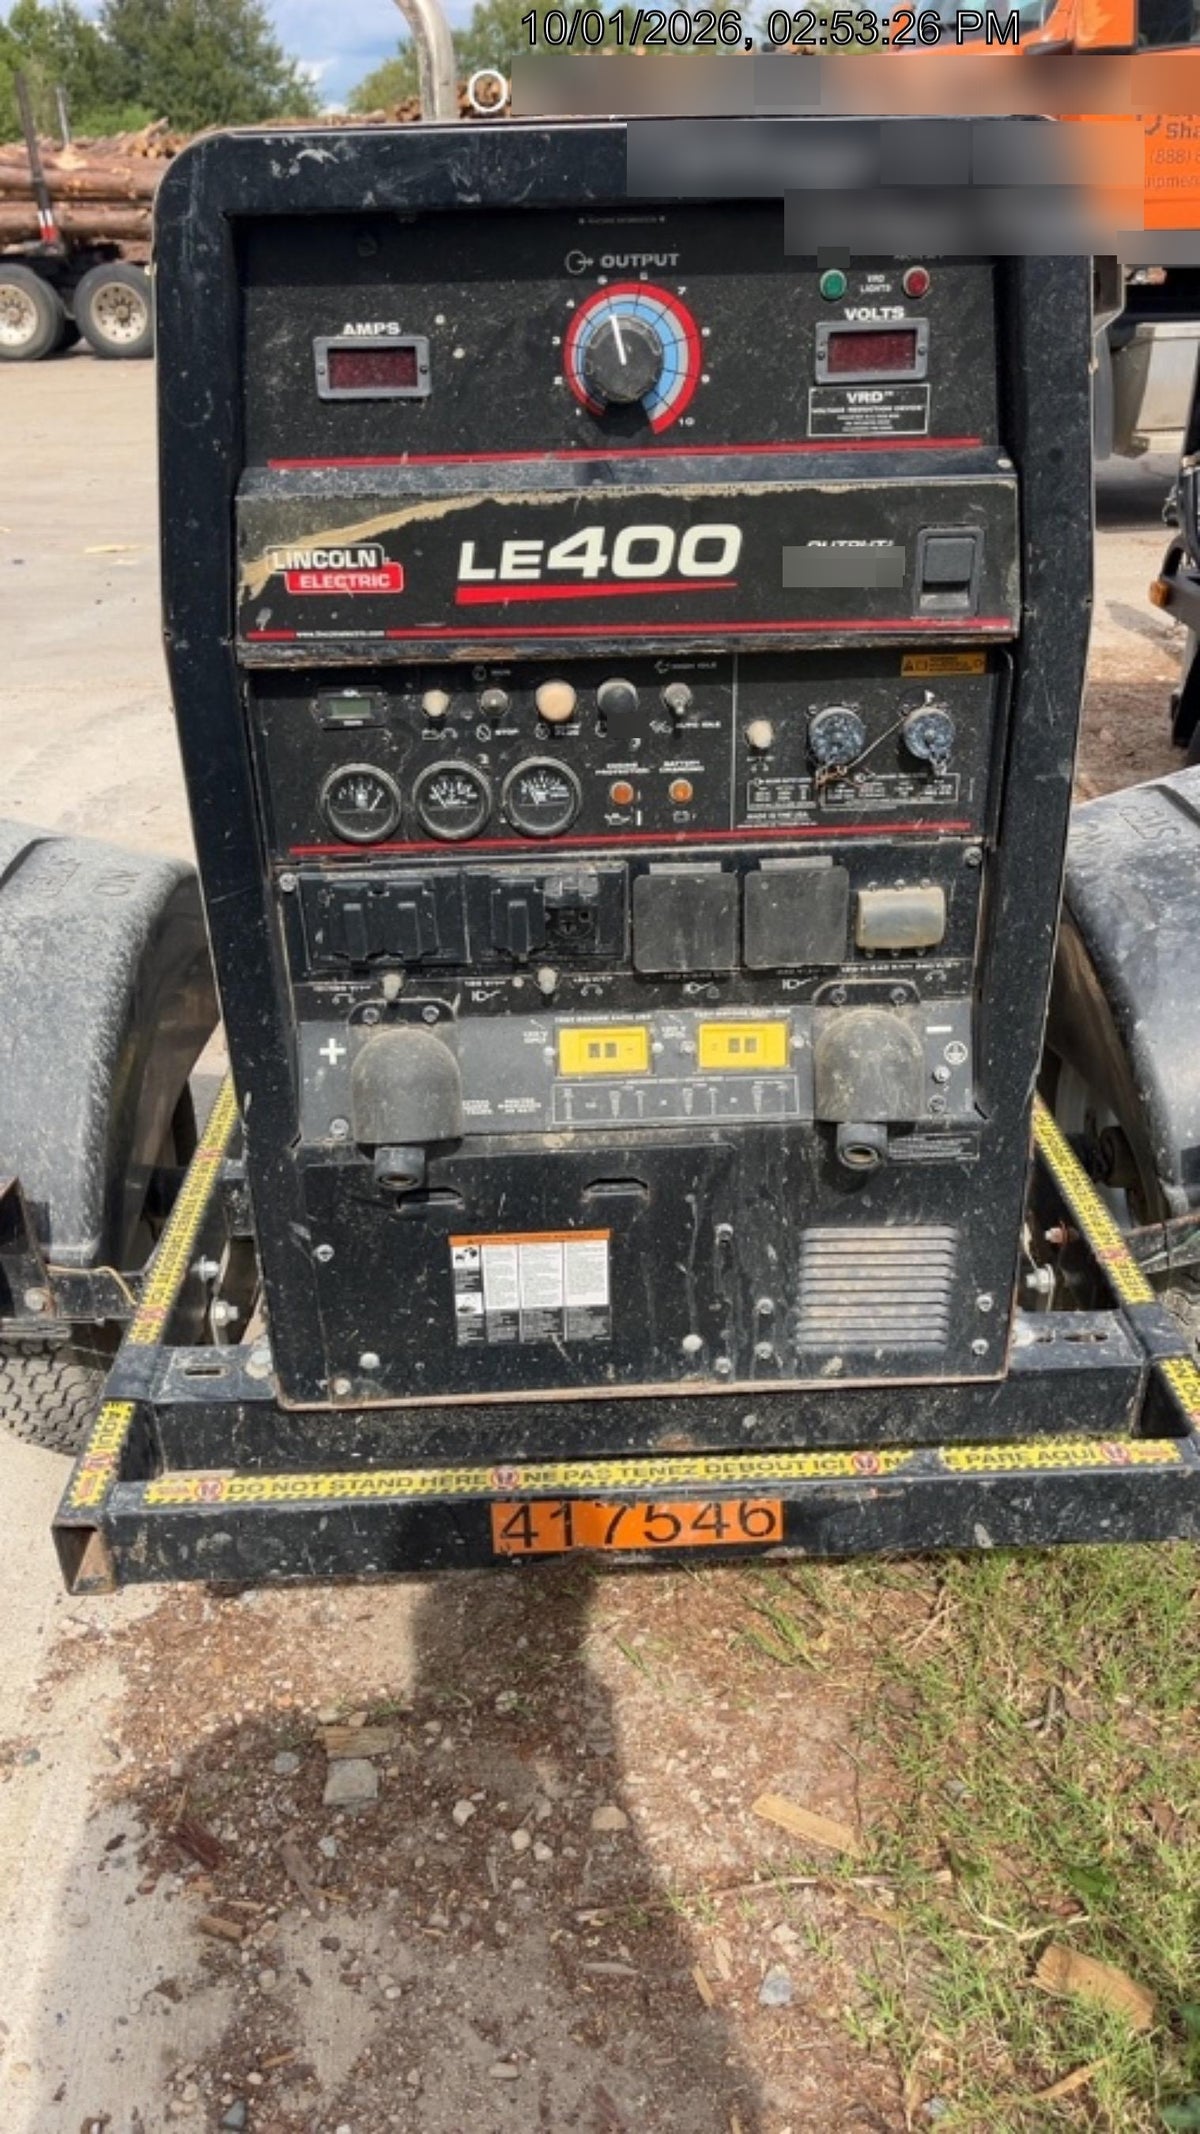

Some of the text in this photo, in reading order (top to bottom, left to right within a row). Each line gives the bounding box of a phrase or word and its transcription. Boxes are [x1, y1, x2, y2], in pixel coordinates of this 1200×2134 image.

[601, 253, 680, 268] OUTPUT
[843, 305, 905, 321] VOLTS
[343, 322, 400, 336] AMPS
[678, 416, 696, 428] 10
[272, 549, 378, 570] LINCOLN
[458, 523, 742, 580] LE400
[300, 573, 391, 589] ELECTRIC
[966, 1452, 1026, 1465] PARE
[227, 1483, 266, 1495] DO
[271, 1480, 322, 1494] NOT
[328, 1476, 413, 1492] STAND
[420, 1474, 488, 1488] HERE
[523, 1470, 557, 1484] NE
[620, 1465, 698, 1479] TENEZ
[703, 1460, 808, 1474] DEBOUT
[813, 1459, 846, 1472] ICI
[501, 1500, 777, 1548] 417546
